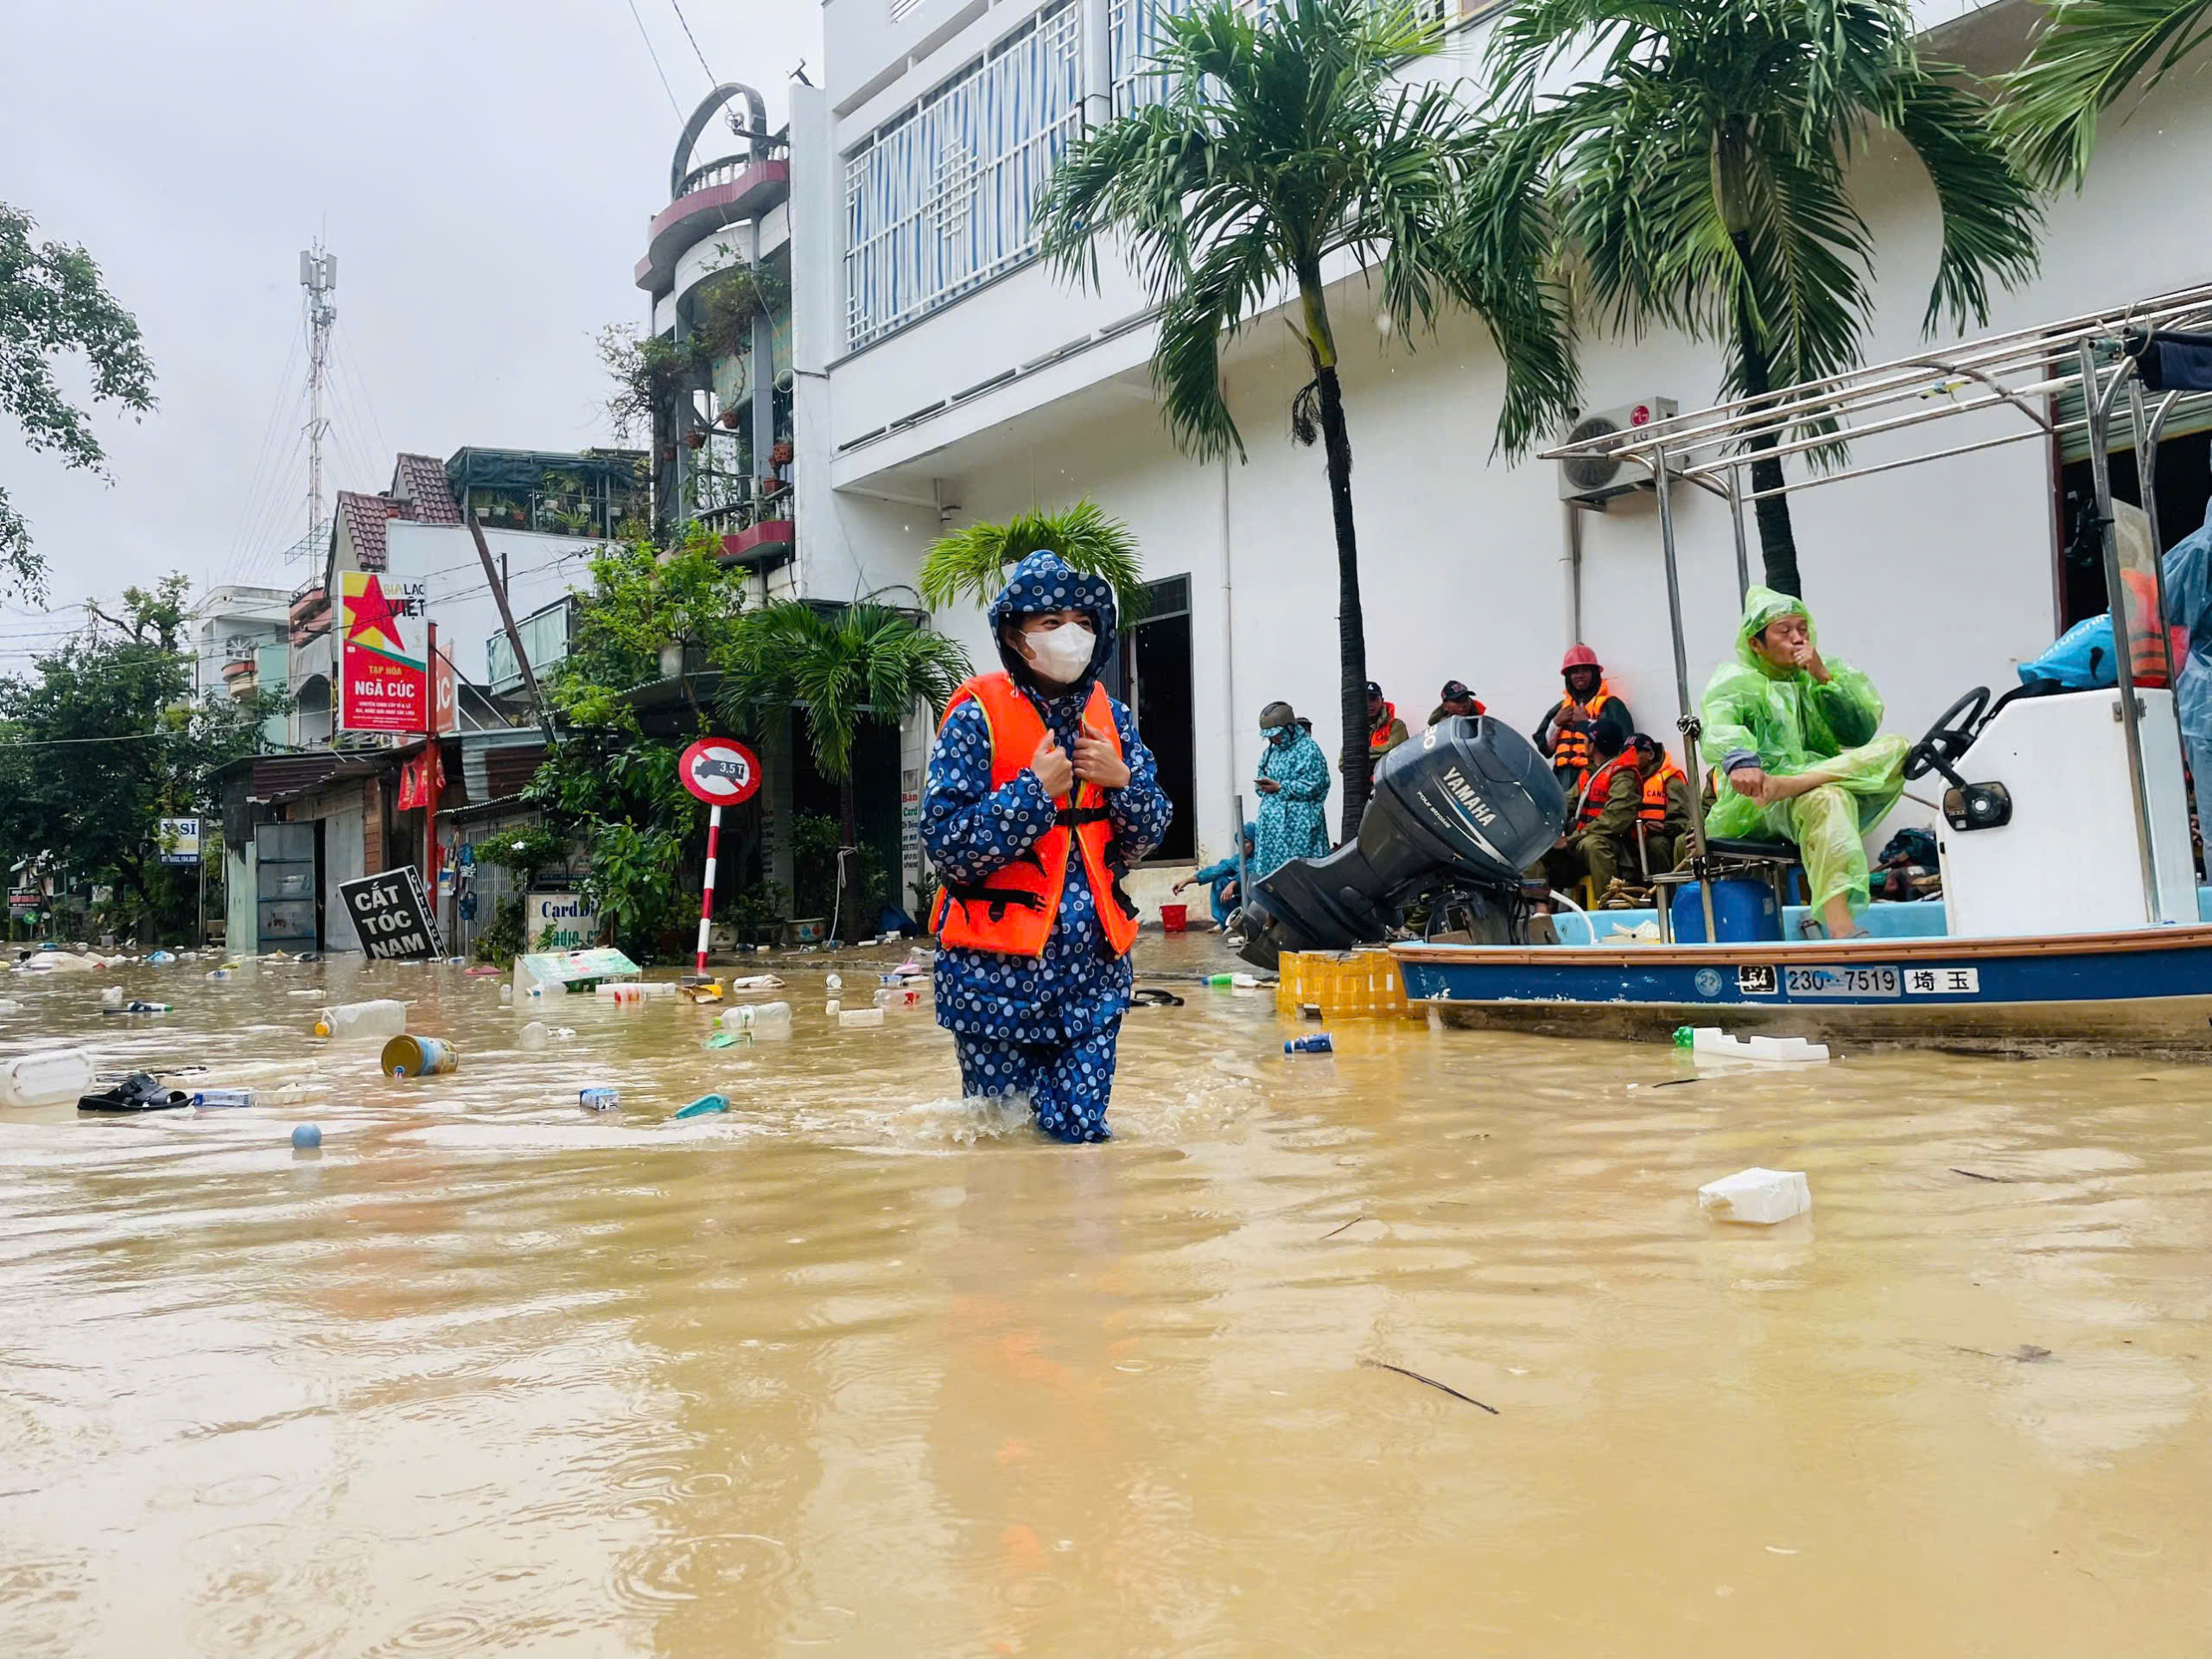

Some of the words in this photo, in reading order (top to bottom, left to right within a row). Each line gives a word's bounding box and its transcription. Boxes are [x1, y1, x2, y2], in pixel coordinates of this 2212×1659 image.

[354, 678, 385, 696] NGÃ
[387, 679, 415, 697] CÚC
[720, 762, 744, 775] 3.5T
[1443, 766, 1497, 827] YAMAHA
[355, 881, 399, 912] CẮT
[542, 901, 577, 918] Card
[361, 909, 412, 935] TÓC
[370, 932, 426, 959] NAM
[1914, 970, 1970, 991] 埼玉
